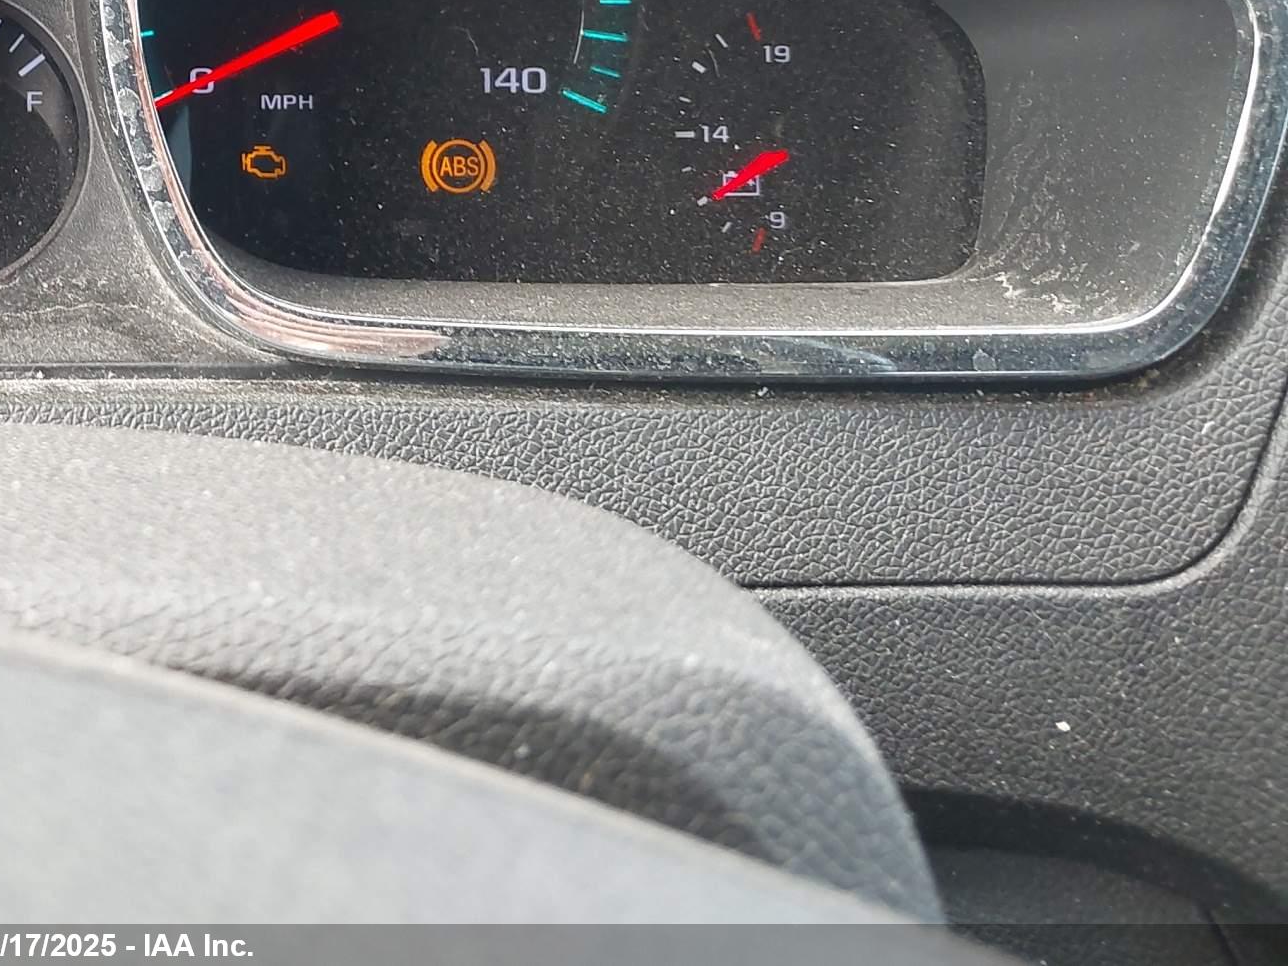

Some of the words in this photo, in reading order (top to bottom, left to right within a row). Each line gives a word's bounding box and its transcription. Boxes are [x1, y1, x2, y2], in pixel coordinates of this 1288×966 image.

[763, 45, 791, 63] 19
[480, 67, 547, 94] 140
[26, 91, 43, 112] F
[261, 94, 313, 110] MPH
[701, 125, 729, 143] 14
[439, 154, 479, 177] ABS
[770, 212, 785, 228] 9
